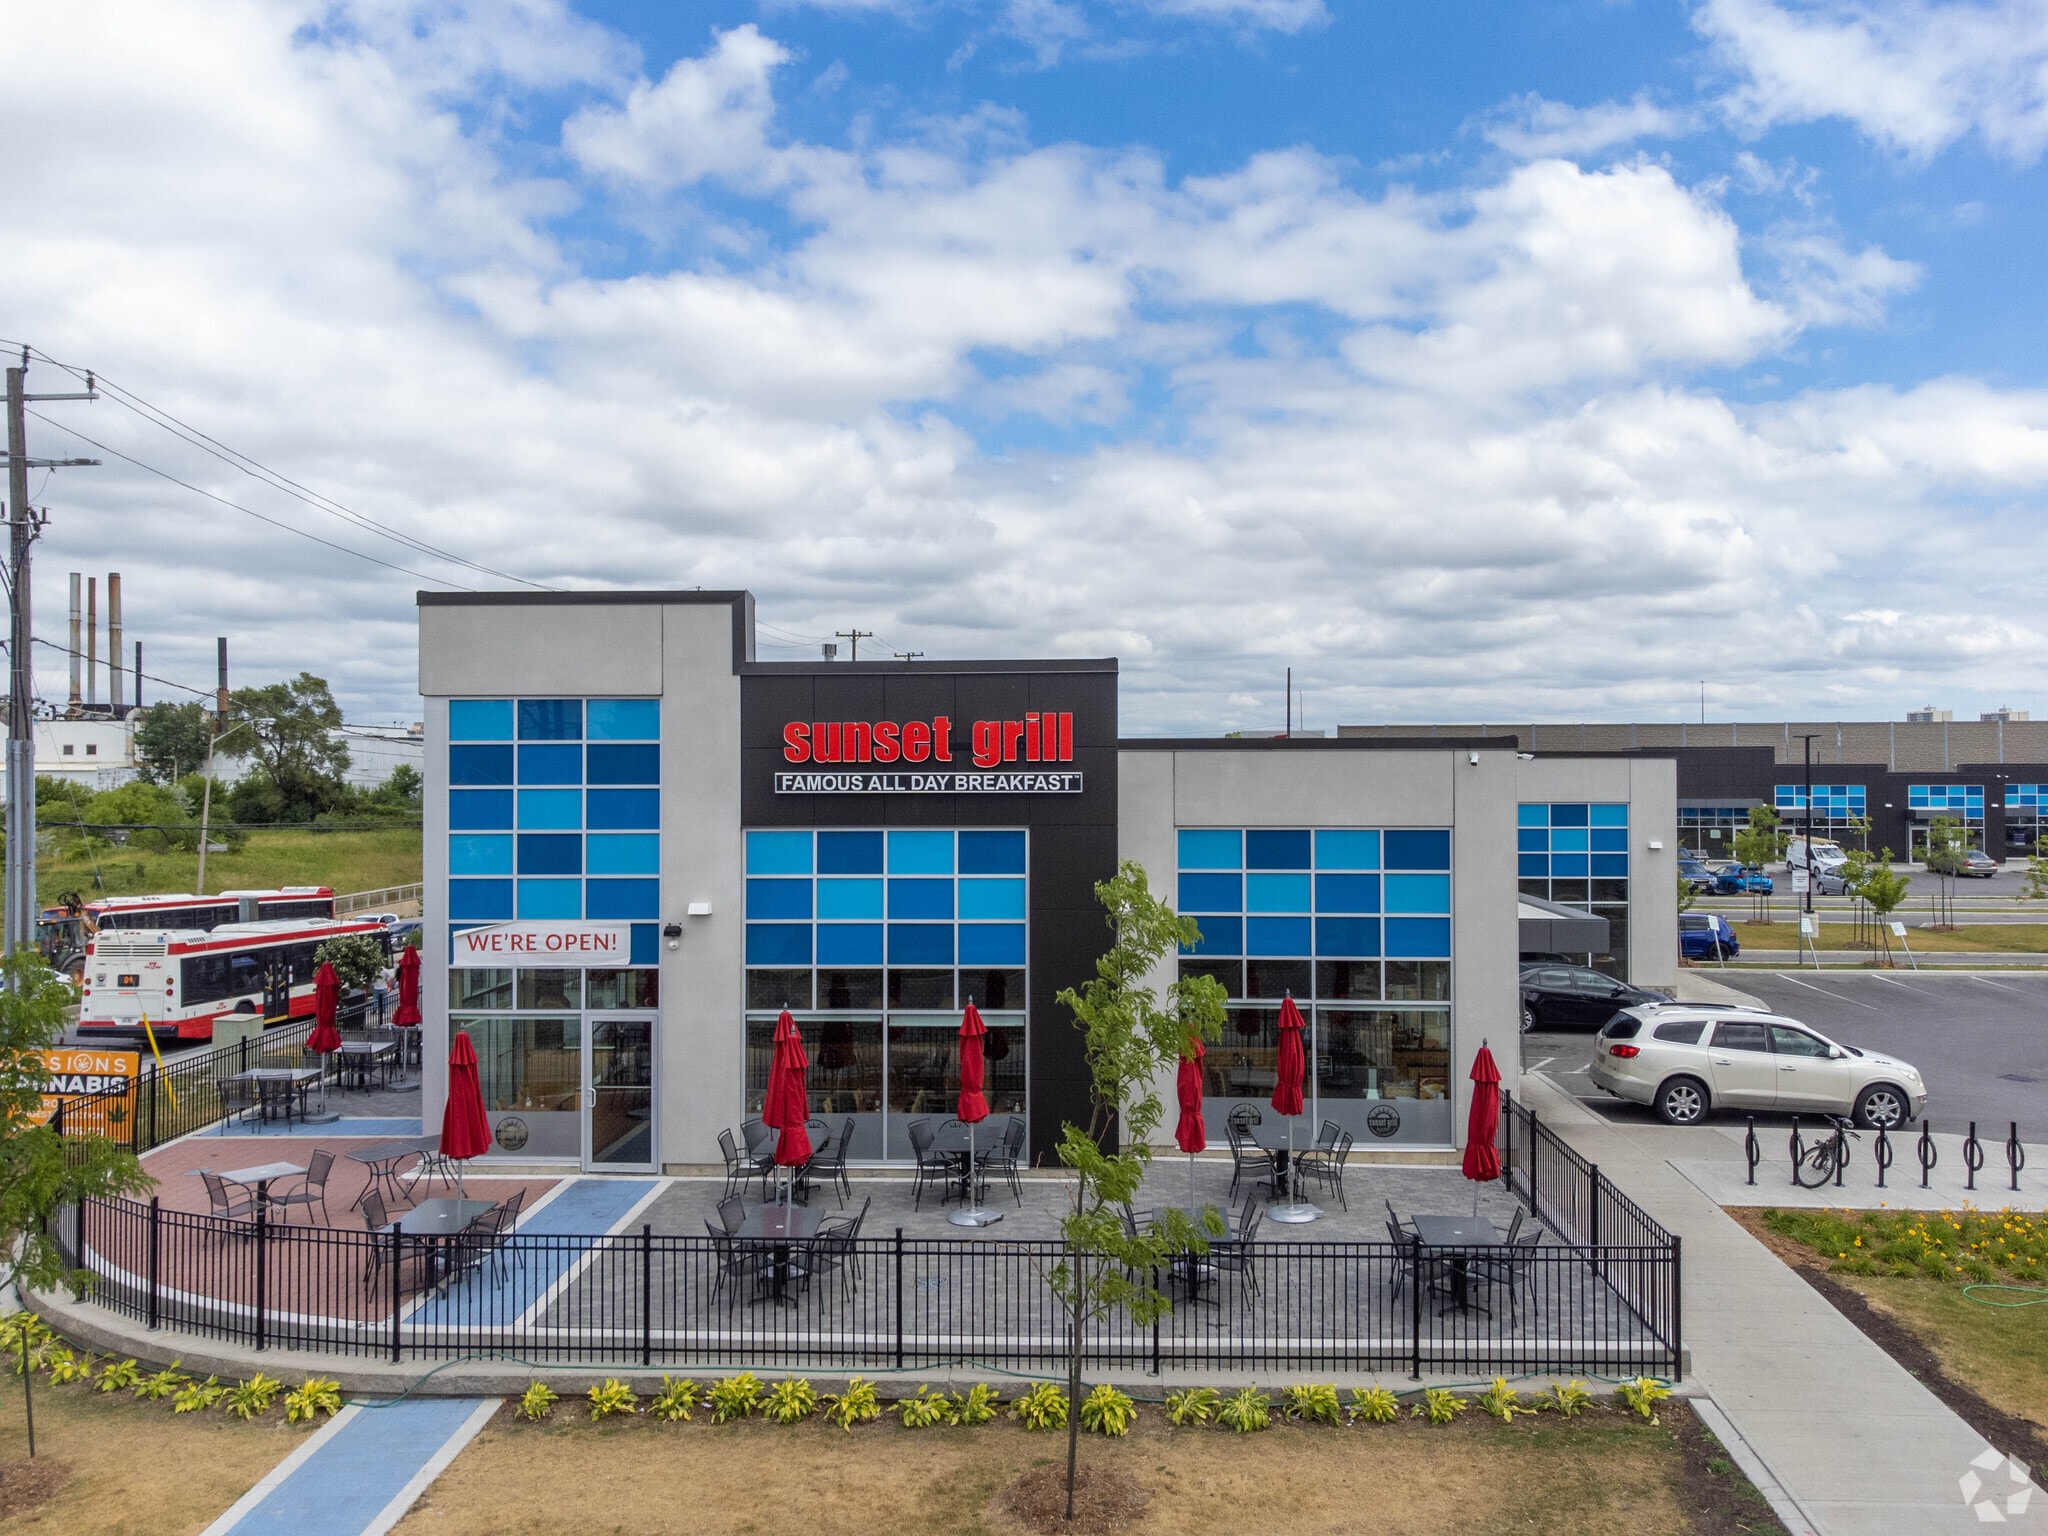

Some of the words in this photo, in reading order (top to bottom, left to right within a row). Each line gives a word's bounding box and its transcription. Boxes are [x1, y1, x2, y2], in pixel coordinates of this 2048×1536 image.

[784, 716, 952, 763] sunset
[972, 712, 1073, 768] grill
[782, 775, 863, 791] FAMOUS
[868, 775, 906, 791] ALL
[911, 775, 950, 791] DAY
[955, 774, 1073, 791] BREAKFAST
[467, 933, 537, 952] WE'RE
[545, 933, 618, 951] OPEN!
